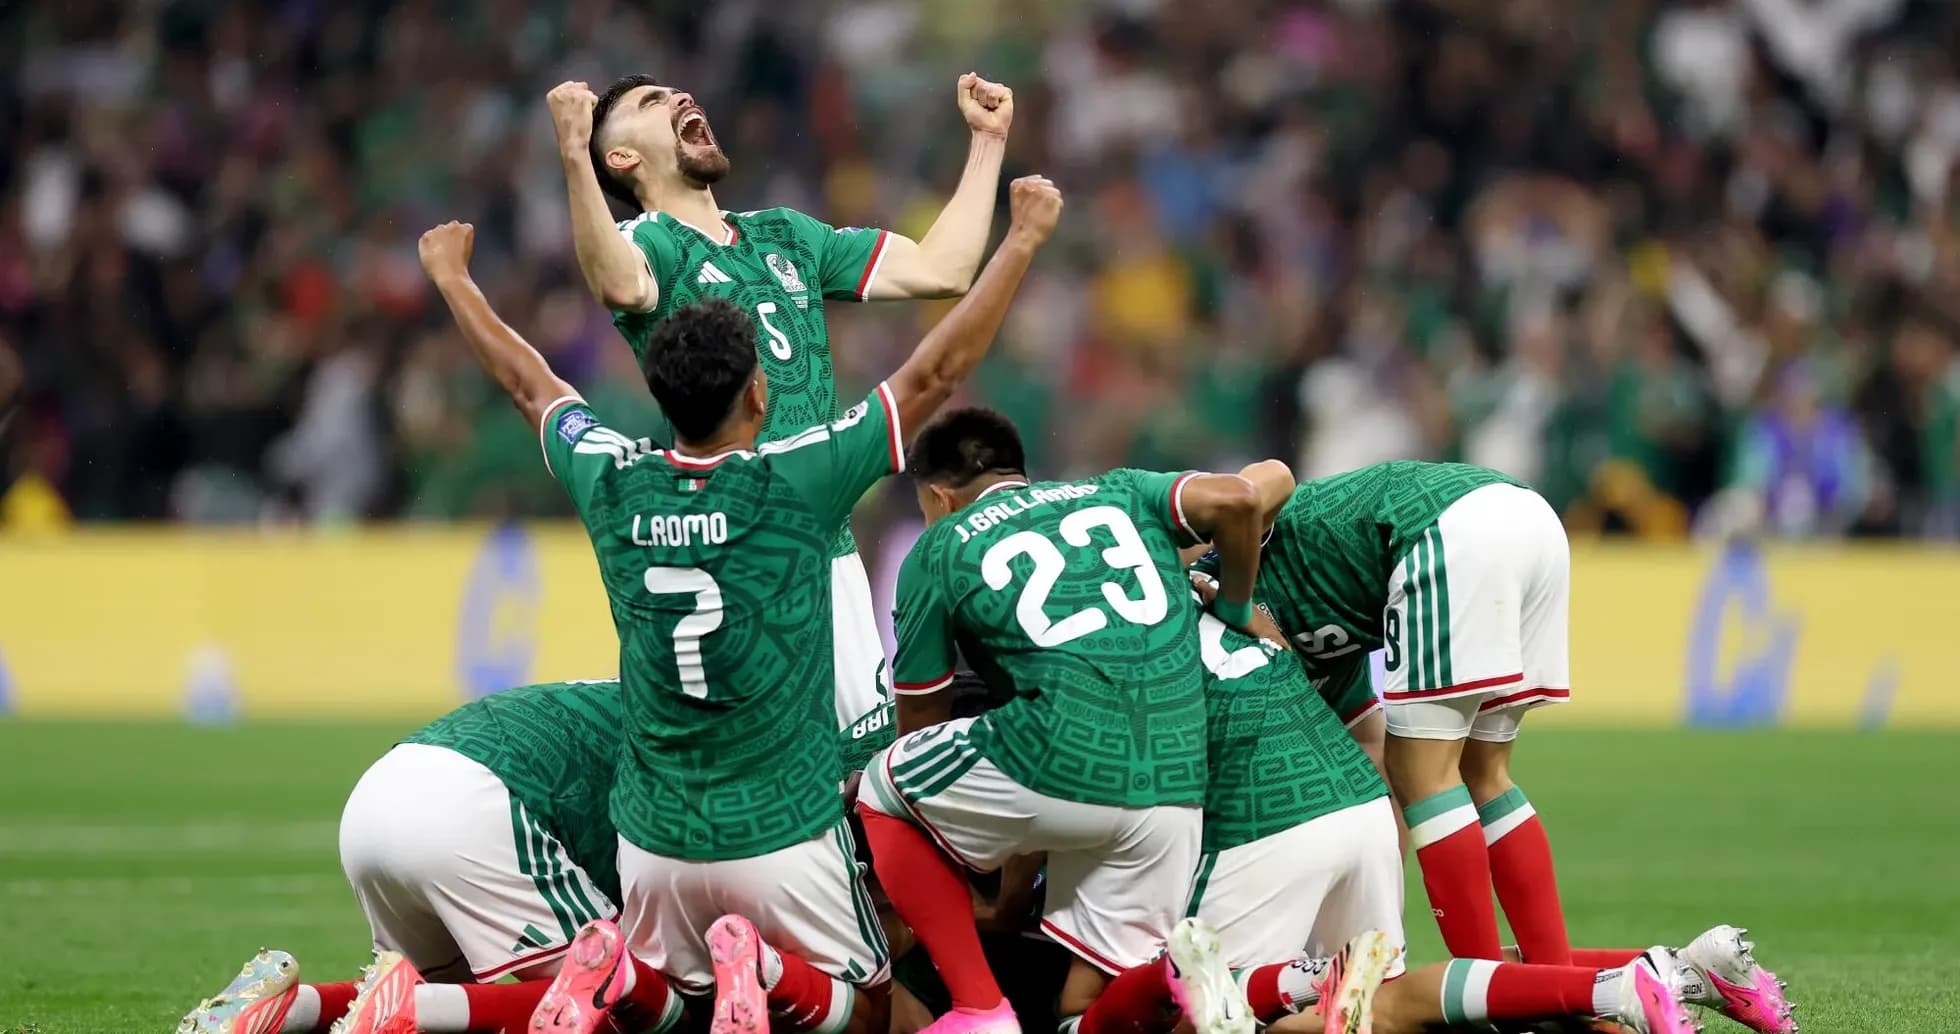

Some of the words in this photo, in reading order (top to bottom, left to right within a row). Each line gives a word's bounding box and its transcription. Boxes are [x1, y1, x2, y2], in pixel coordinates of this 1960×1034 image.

[757, 302, 792, 360] 5
[632, 512, 728, 547] L.ROMO
[981, 505, 1168, 648] 23
[644, 566, 724, 700] 7
[1192, 590, 1283, 681] 2
[852, 702, 896, 739] IRA
